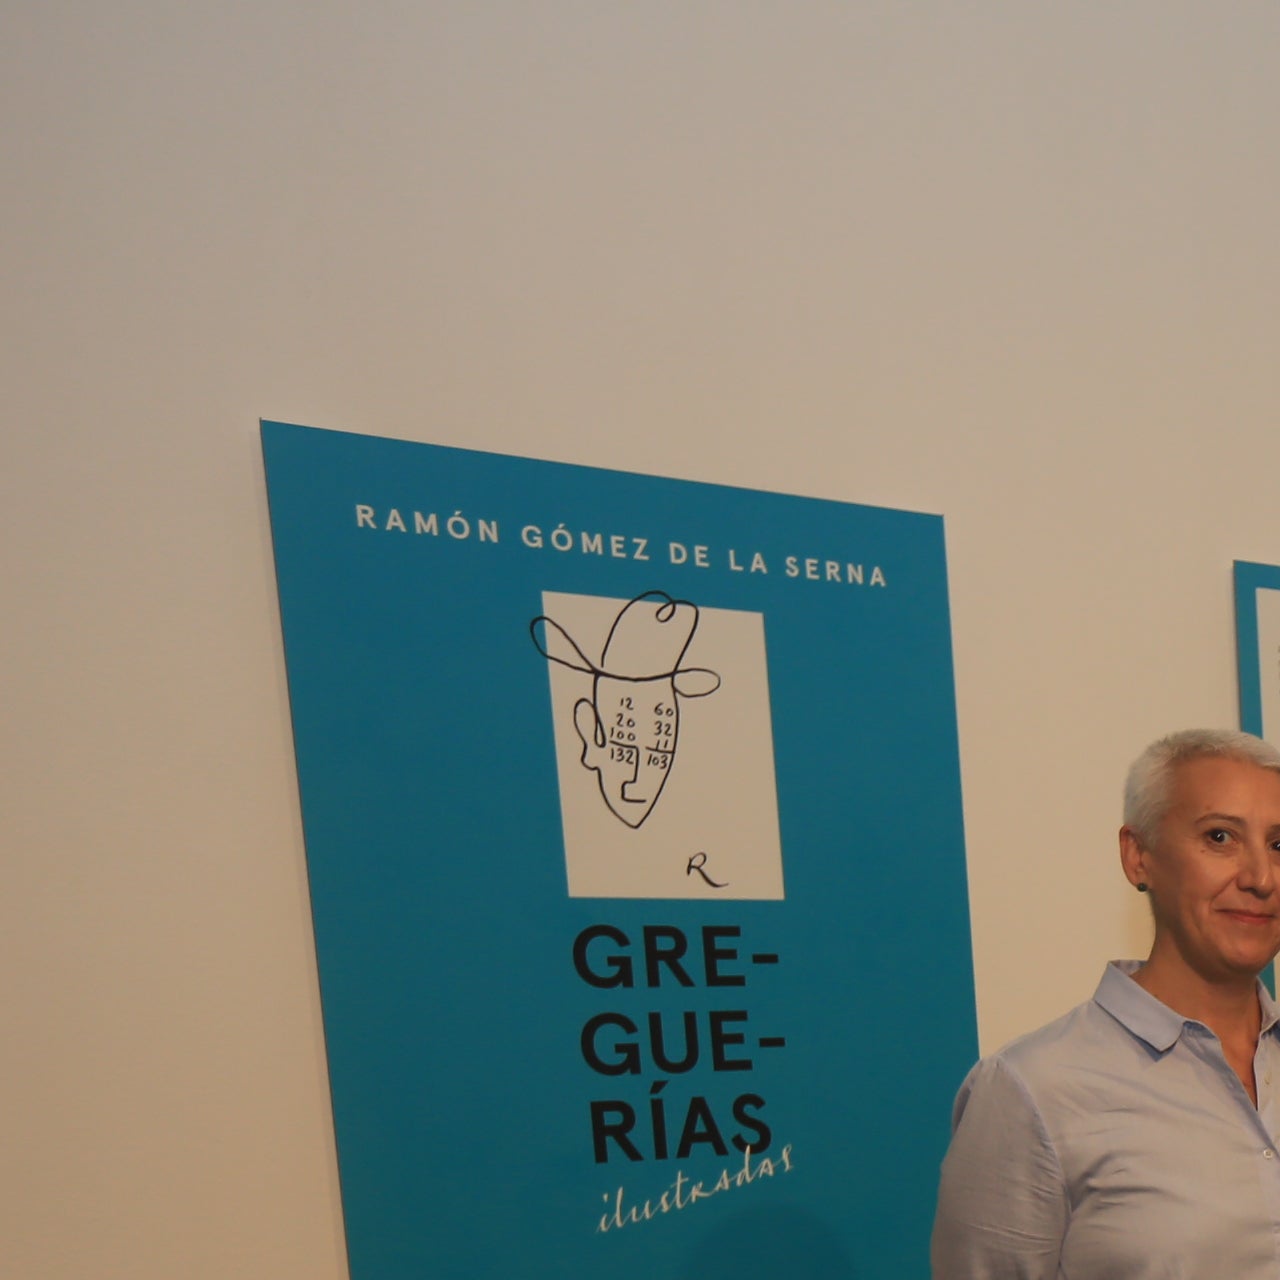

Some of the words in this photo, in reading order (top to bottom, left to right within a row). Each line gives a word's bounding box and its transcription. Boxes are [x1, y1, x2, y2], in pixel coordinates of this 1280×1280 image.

[356, 504, 499, 543] RAMÓN
[521, 523, 650, 561] GÓMEZ
[669, 542, 711, 567] DE
[729, 550, 768, 573] LA
[785, 556, 887, 587] SERNA
[620, 697, 634, 710] 12
[654, 702, 674, 717] 60
[616, 712, 635, 728] 20
[654, 720, 672, 737] 32
[610, 726, 636, 741] 100
[610, 747, 634, 765] 132
[647, 753, 668, 770] 103
[572, 924, 779, 990] GRE-
[580, 1010, 785, 1077] GUE-
[590, 1080, 771, 1164] RÍAS
[595, 1144, 794, 1233] ilustradas
